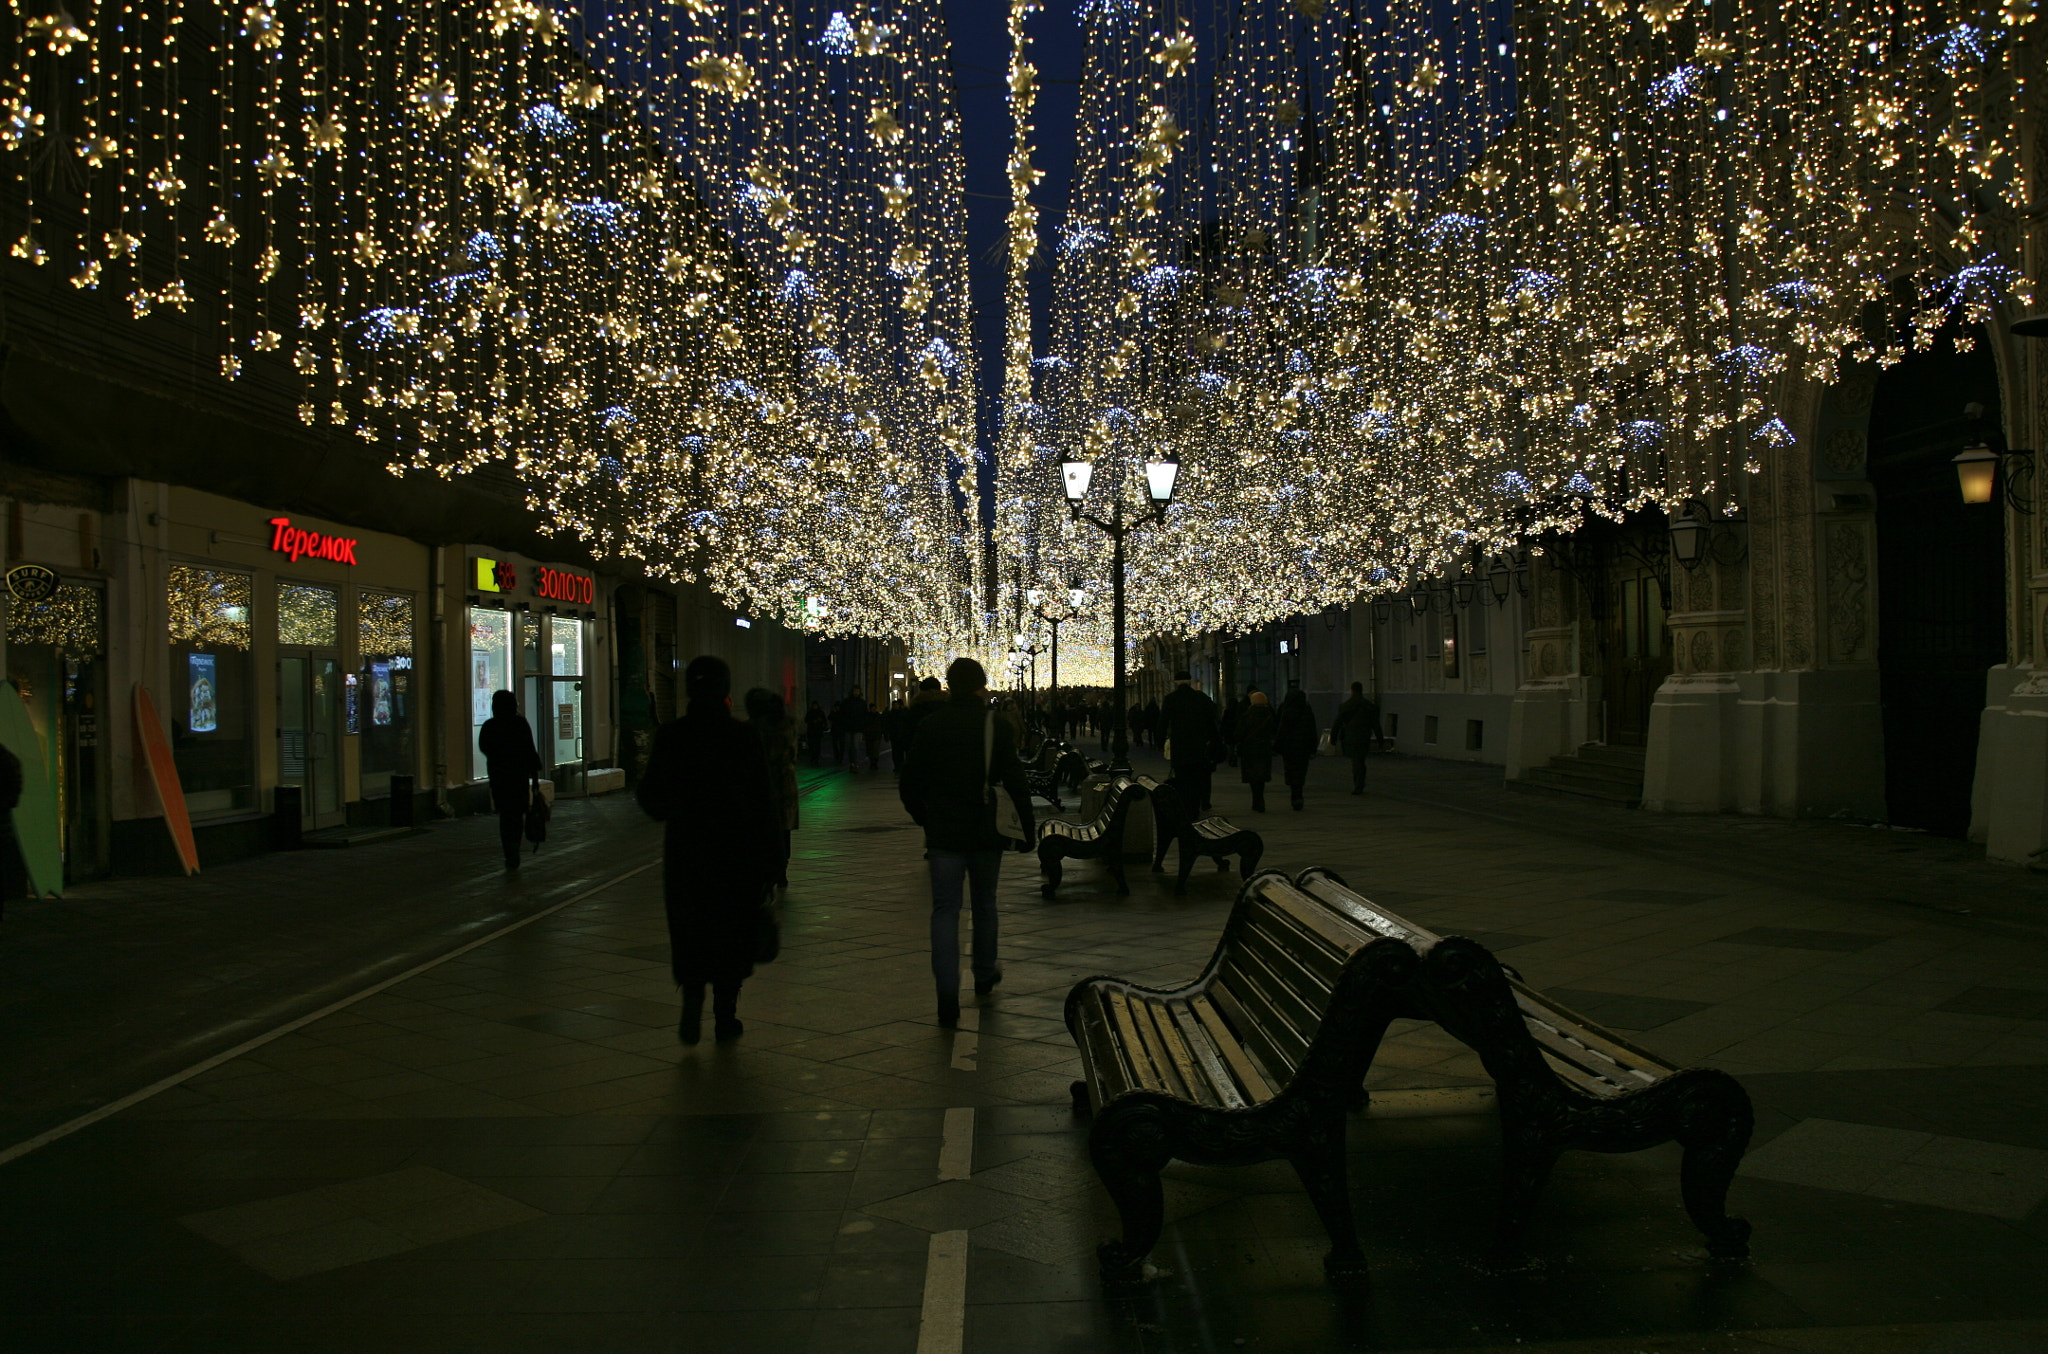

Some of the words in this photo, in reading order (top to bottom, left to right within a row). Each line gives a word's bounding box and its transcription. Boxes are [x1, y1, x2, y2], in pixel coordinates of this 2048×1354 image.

[270, 518, 358, 566] Теремок
[12, 568, 48, 580] SURF
[539, 566, 593, 604] ЗОЛОТО
